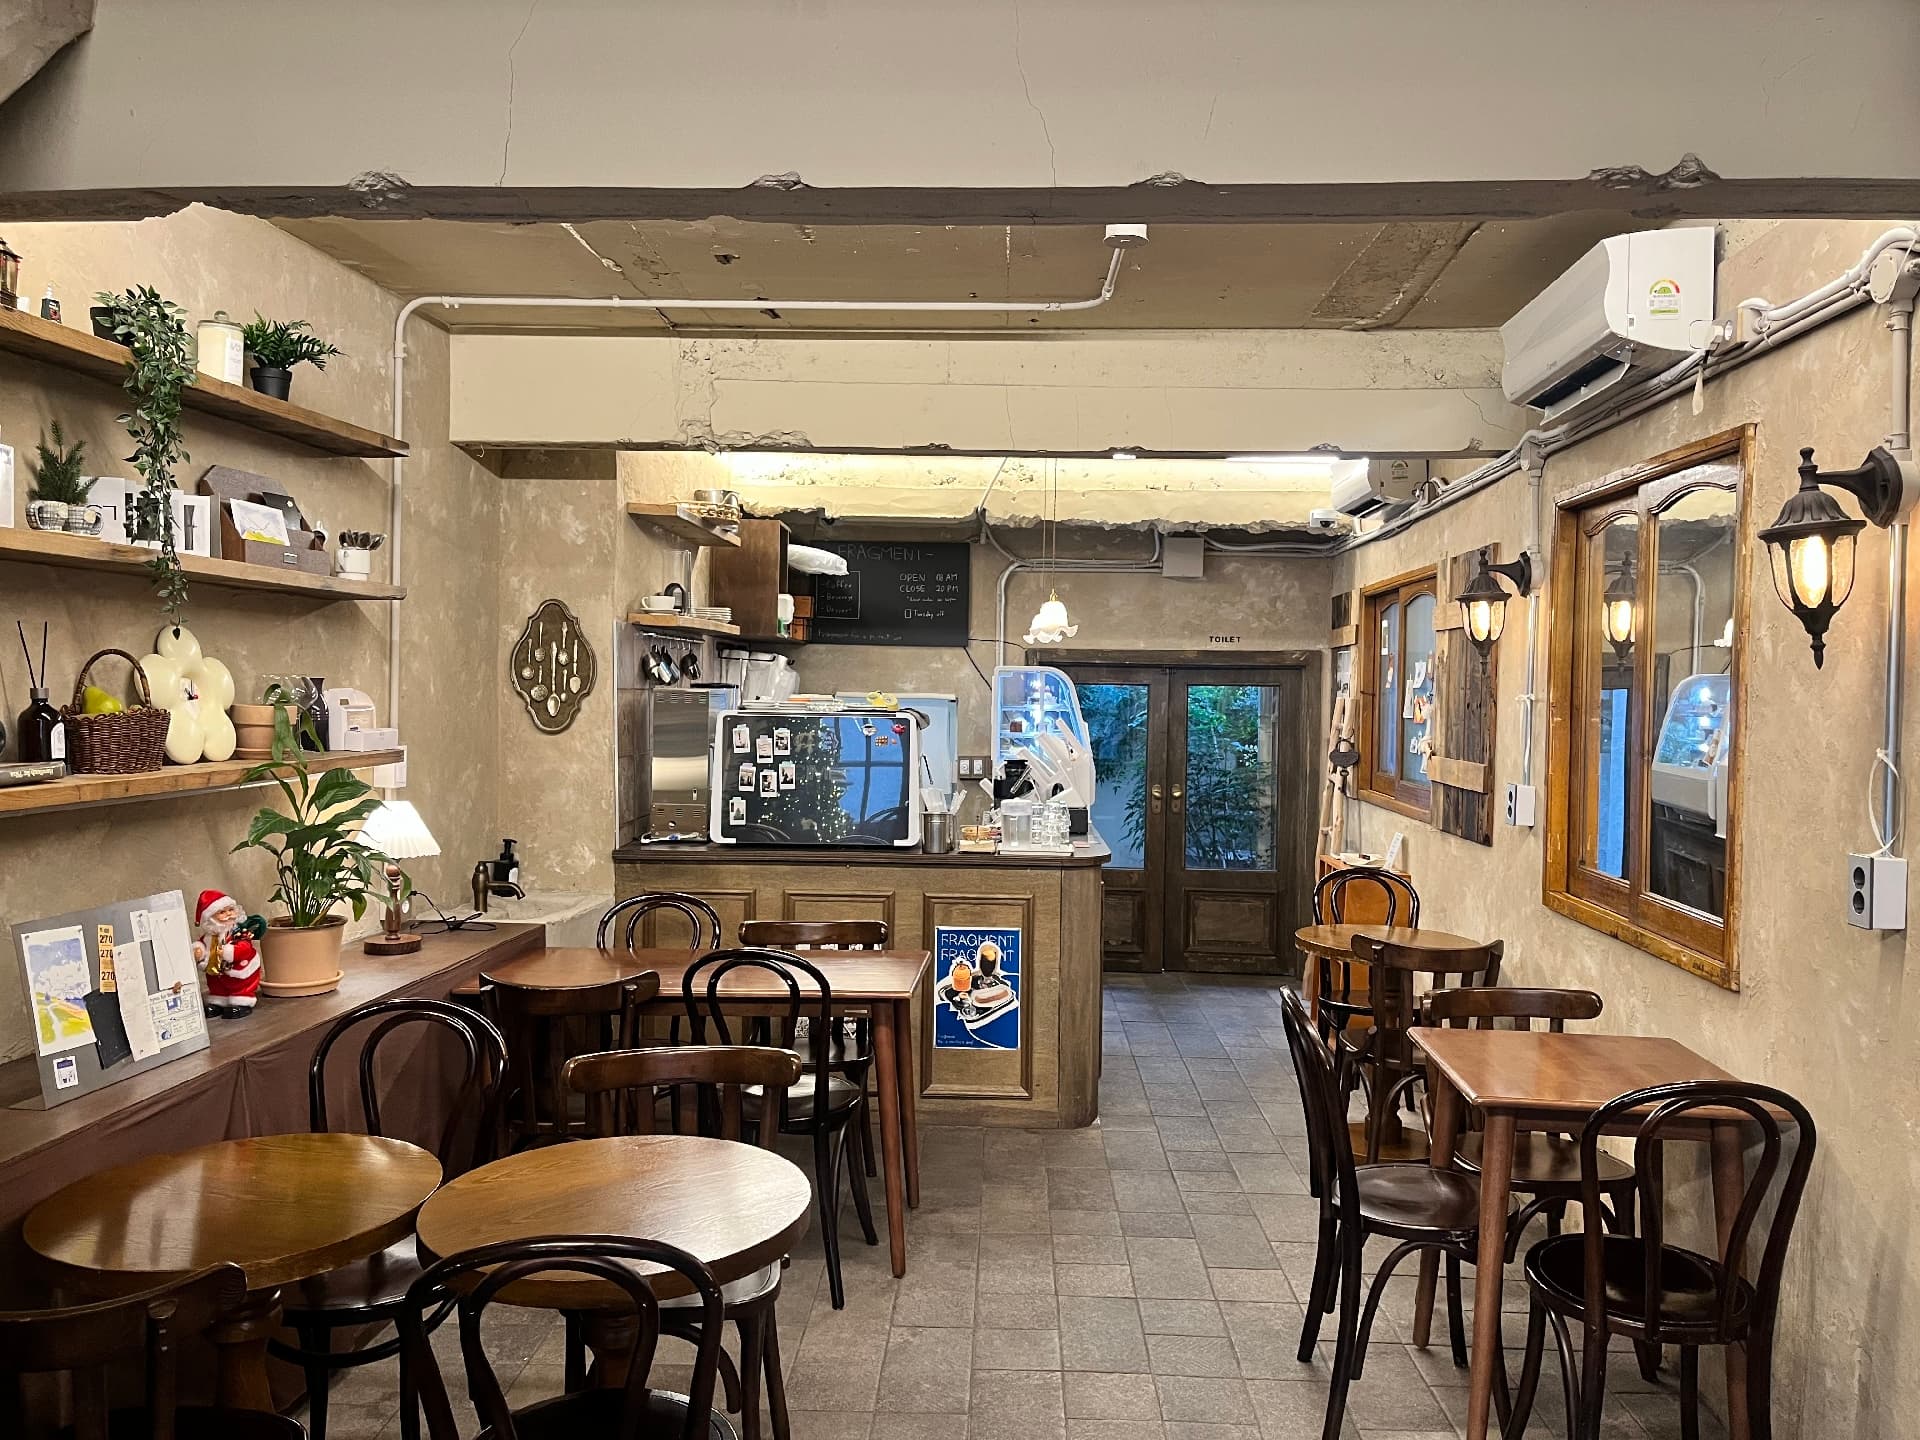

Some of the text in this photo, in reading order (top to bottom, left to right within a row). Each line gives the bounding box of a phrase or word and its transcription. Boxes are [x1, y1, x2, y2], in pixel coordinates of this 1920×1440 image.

[900, 573, 926, 582] OPEN
[945, 573, 958, 582] AM
[900, 584, 959, 593] CLOSE 20 PM
[99, 934, 113, 944] 270
[941, 948, 1015, 962] FRAGNT
[101, 971, 115, 981] 270
